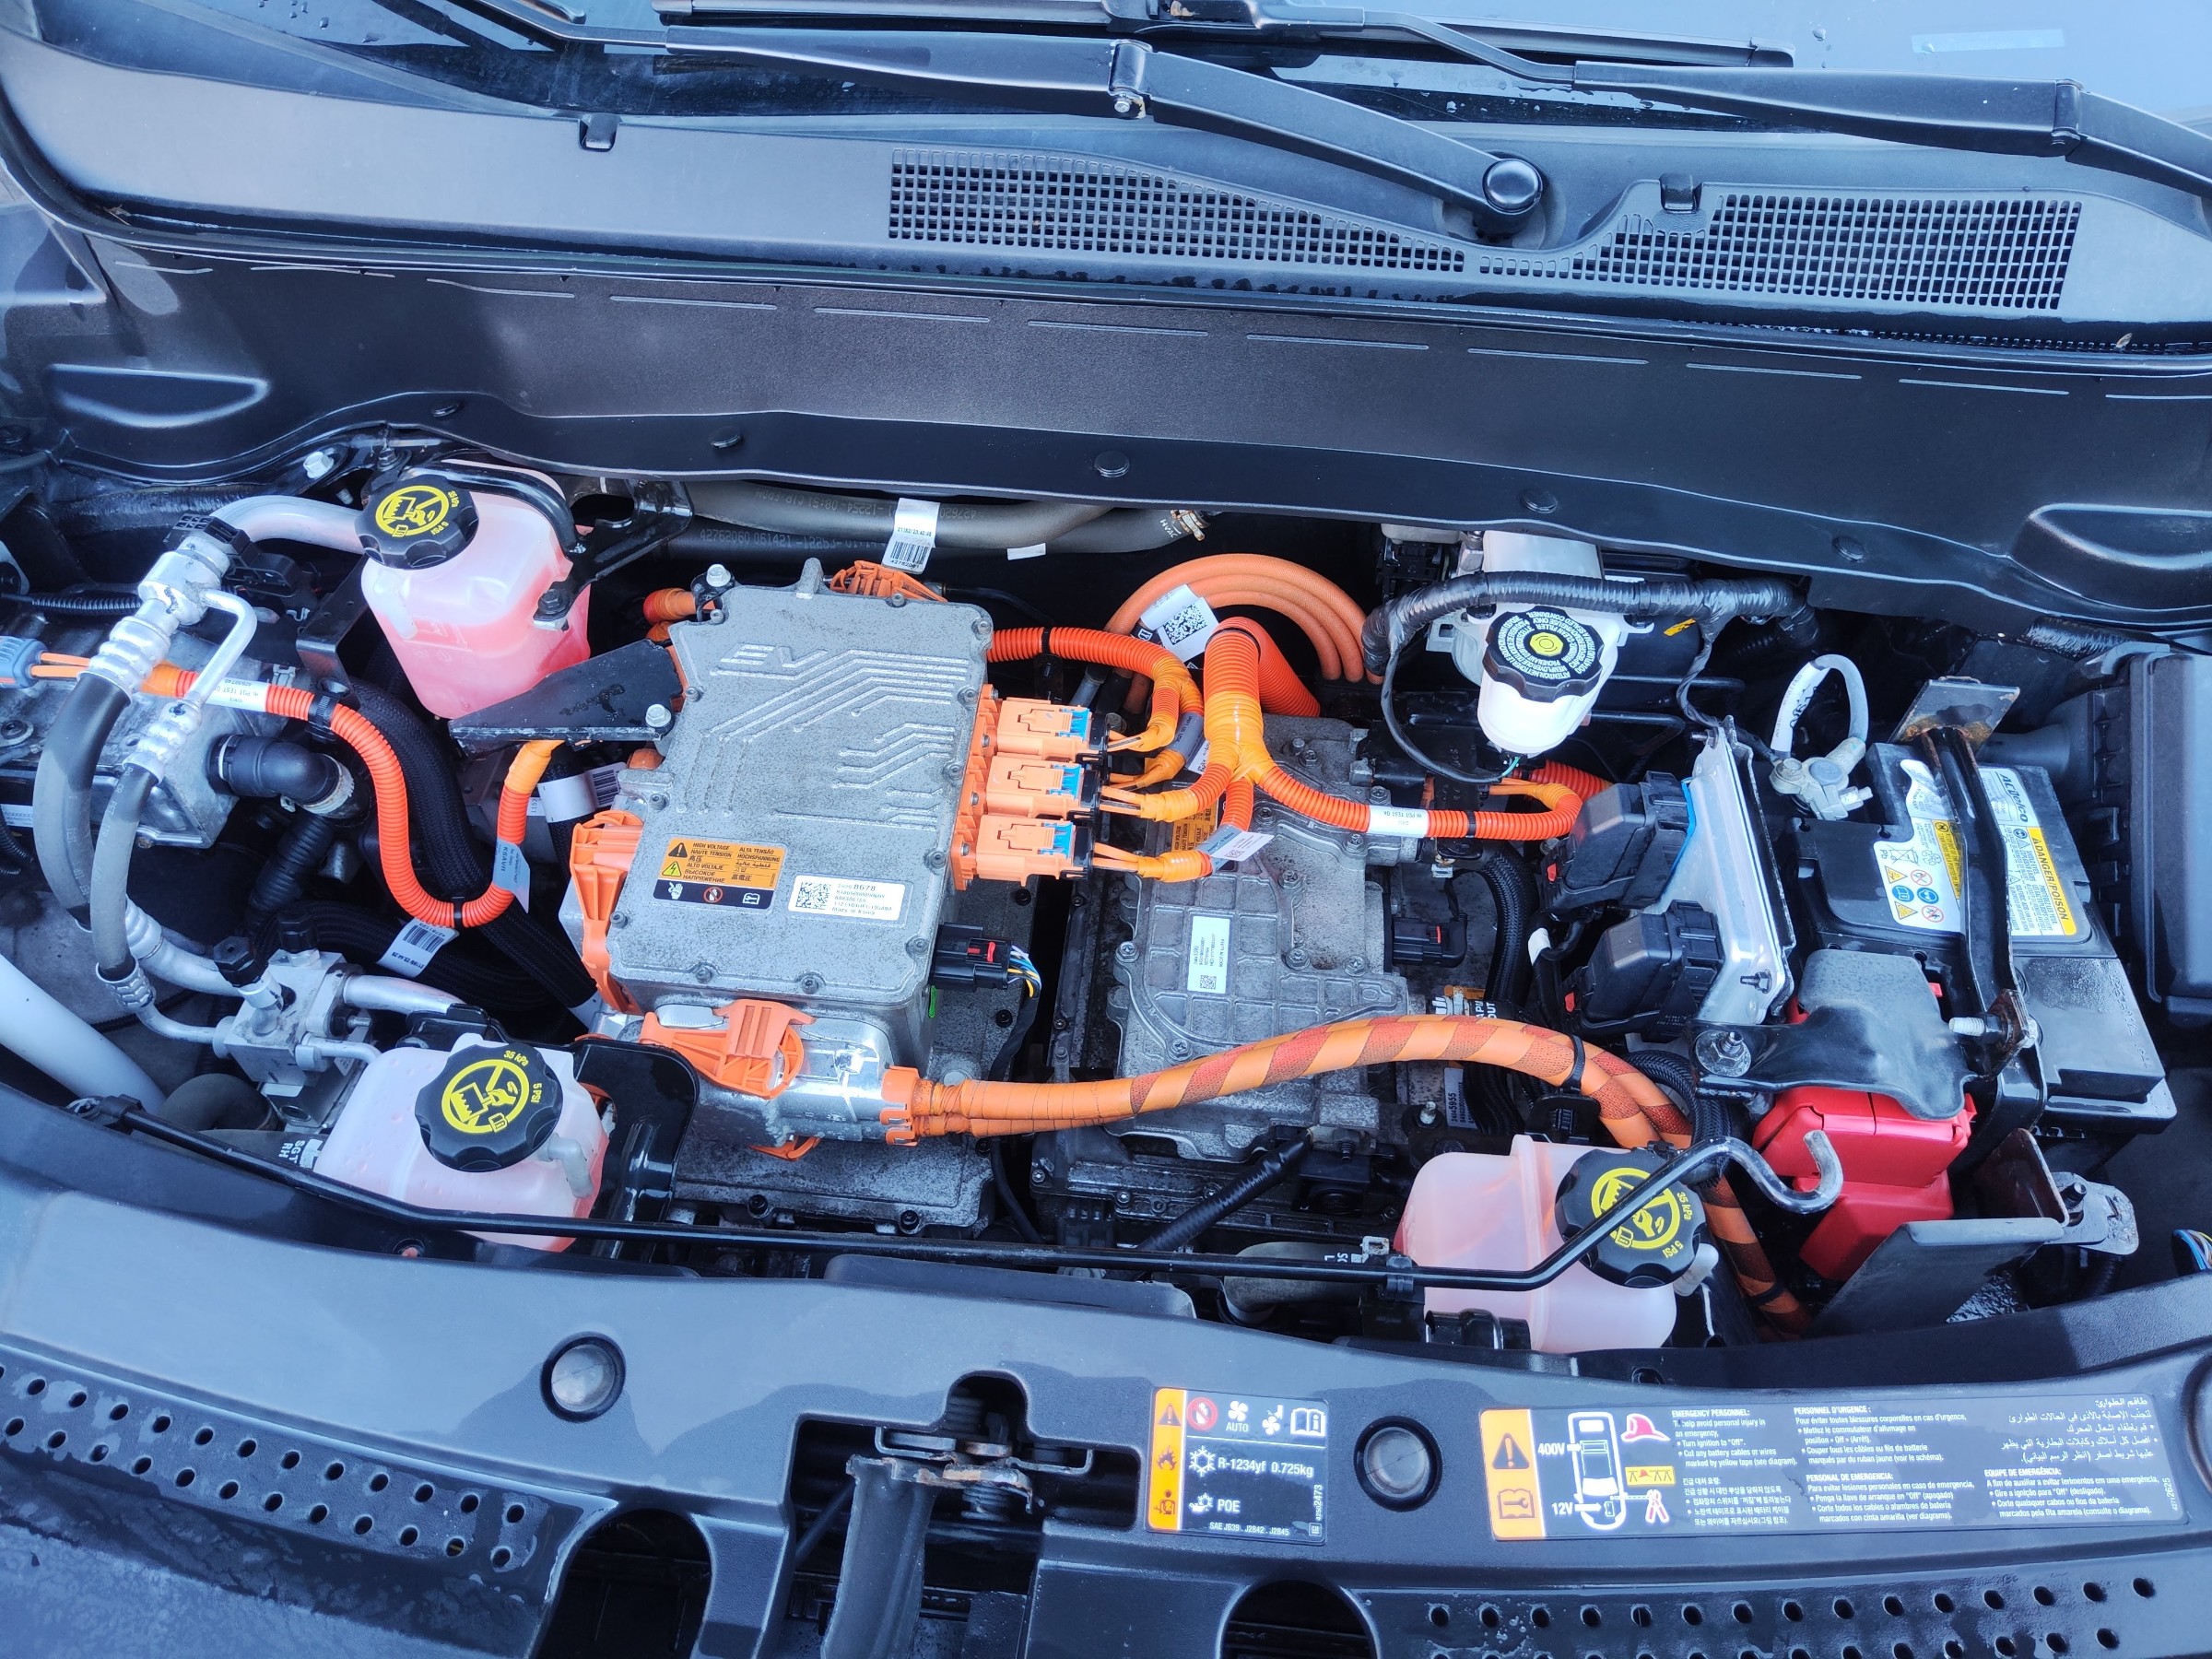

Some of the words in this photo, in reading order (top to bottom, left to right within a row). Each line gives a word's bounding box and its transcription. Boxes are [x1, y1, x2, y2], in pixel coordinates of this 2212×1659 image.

[1160, 519, 1178, 538] HVAC
[700, 529, 749, 545] 42762060
[2000, 773, 2029, 823] ACDelco
[737, 853, 781, 862] HOCHSPANNUNG
[1879, 849, 1888, 859] Pb
[683, 875, 725, 883] НАПРЯЖЕНИЕ
[2035, 845, 2068, 920] DANGER/POISON
[503, 1050, 514, 1059] 35
[514, 1052, 530, 1067] kPa
[531, 1089, 542, 1103] PSI
[278, 1143, 293, 1158] RH
[1677, 1191, 1688, 1203] 35
[1681, 1203, 1693, 1220] kPa
[1677, 1240, 1684, 1249] 5
[1663, 1244, 1679, 1259] PSI
[1672, 1409, 1710, 1418] EMERGENCY
[1711, 1408, 1750, 1417] PERSONNEL:
[1794, 1406, 1830, 1415] PERSONNEL
[1831, 1406, 1867, 1414] D'URGENCE
[1713, 1418, 1740, 1429] personal
[1741, 1418, 1759, 1428] injury
[1879, 1415, 1912, 1423] corporelles
[1935, 1414, 1967, 1422] d'urgence,
[1226, 1422, 1249, 1432] AUTO
[1684, 1430, 1719, 1439] emergency,
[1537, 1442, 1565, 1455] 400V
[1697, 1439, 1720, 1448] ignition
[1806, 1447, 1828, 1455] Couper
[1904, 1443, 1928, 1452] batterie
[1695, 1450, 1707, 1458] any
[1708, 1449, 1729, 1457] battery
[1218, 1456, 1266, 1474] R-1234yf
[1271, 1462, 1314, 1477] 0.725kg
[1686, 1459, 1709, 1467] marked
[1710, 1459, 1717, 1467] by
[1718, 1458, 1737, 1467] yellow
[1739, 1458, 1752, 1466] tape
[1754, 1457, 1767, 1466] (see
[1768, 1457, 1797, 1465] diagram).
[1984, 1468, 2007, 1477] EQUIPE
[2008, 1468, 2018, 1477] DE
[2018, 1466, 2062, 1477] EMERGÊNCIA:
[1806, 1474, 1840, 1482] PERSONAL
[1851, 1473, 1894, 1481] EMERGENCIA:
[1815, 1494, 1835, 1502] Ponga
[1843, 1493, 1858, 1501] llave
[1868, 1493, 1896, 1501] arranque
[1923, 1491, 1954, 1500] (apagado)
[1218, 1499, 1241, 1512] POE
[1551, 1502, 1574, 1515] 12V
[1996, 1500, 2014, 1508] Corte
[2015, 1500, 2045, 1508] quaisquer
[1209, 1522, 1223, 1530] SAE
[1223, 1524, 1240, 1532] J639
[1244, 1525, 1265, 1534] J2842
[1269, 1527, 1289, 1535] J2845
